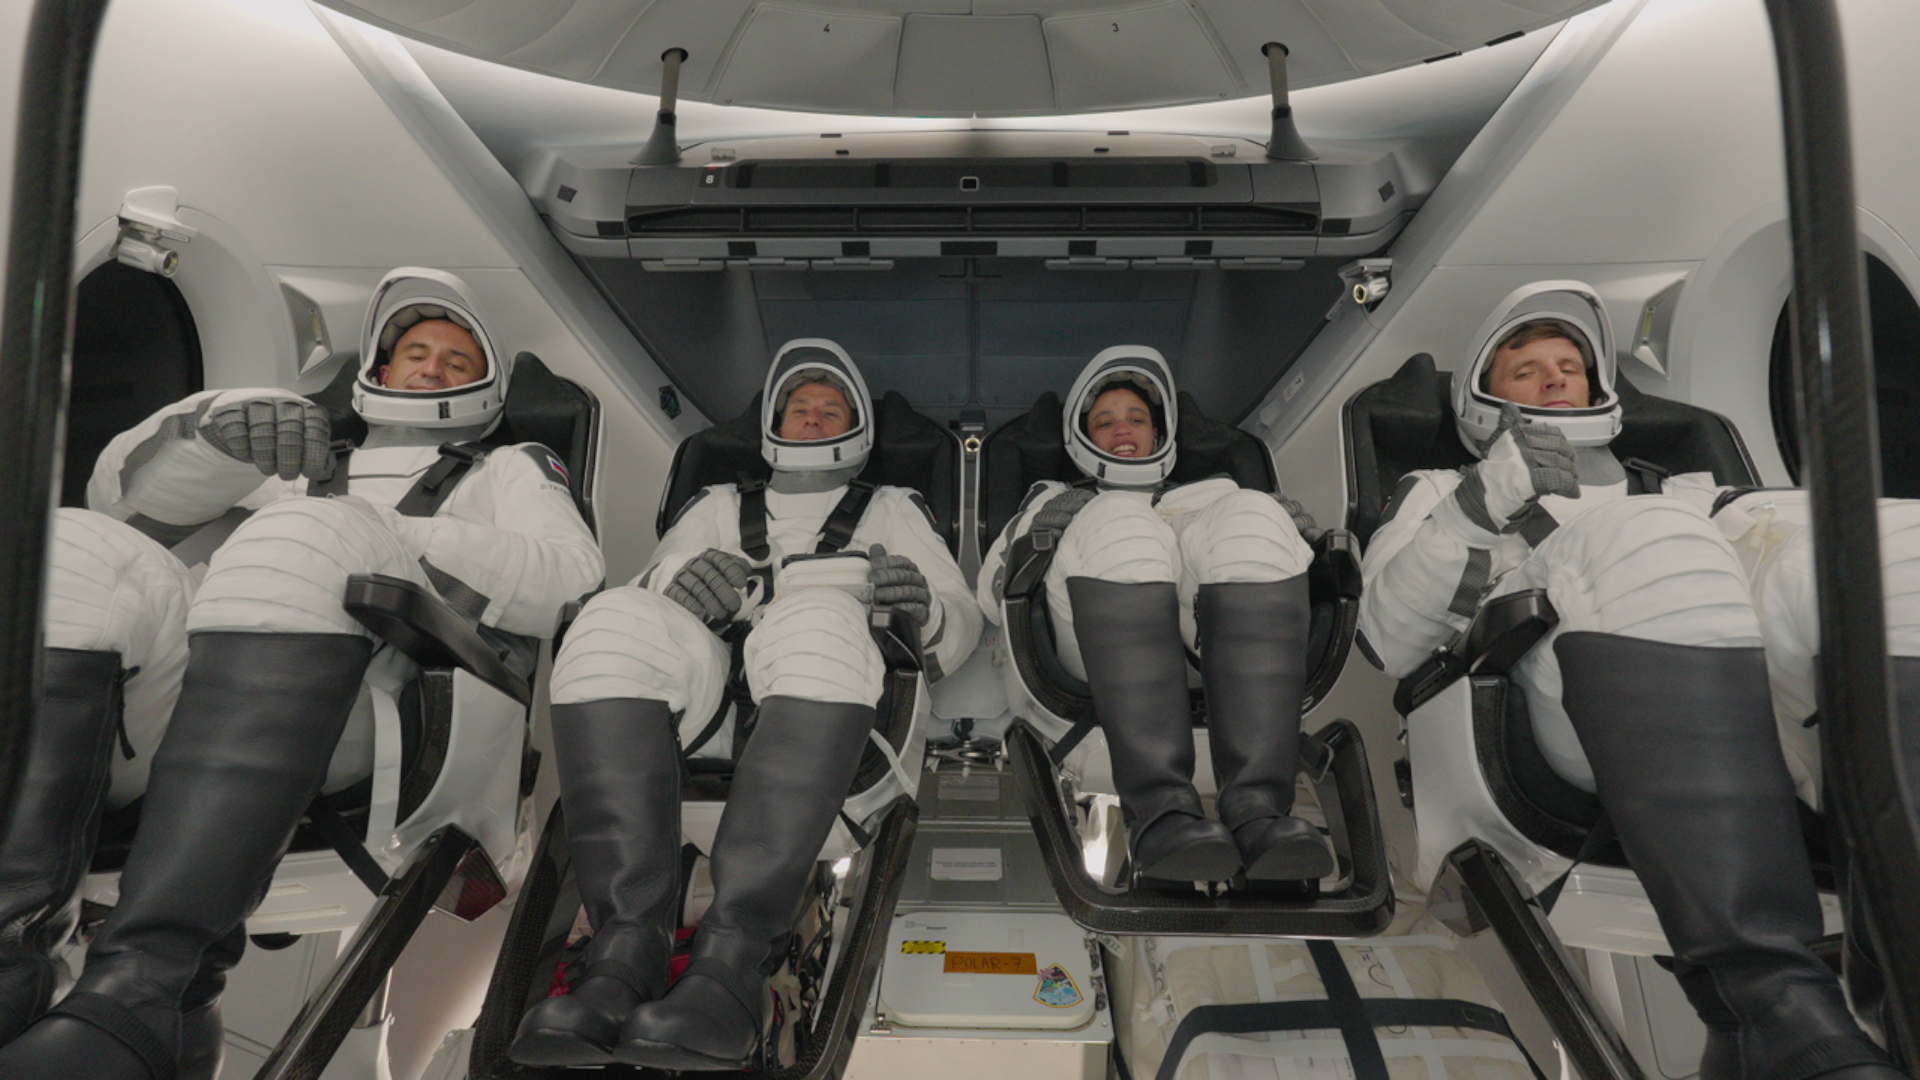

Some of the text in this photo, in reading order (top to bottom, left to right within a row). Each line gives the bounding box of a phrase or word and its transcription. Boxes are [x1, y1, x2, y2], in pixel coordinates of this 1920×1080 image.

[1111, 22, 1119, 33] 3
[705, 174, 715, 184] 8
[951, 956, 1023, 971] POLAR-7
